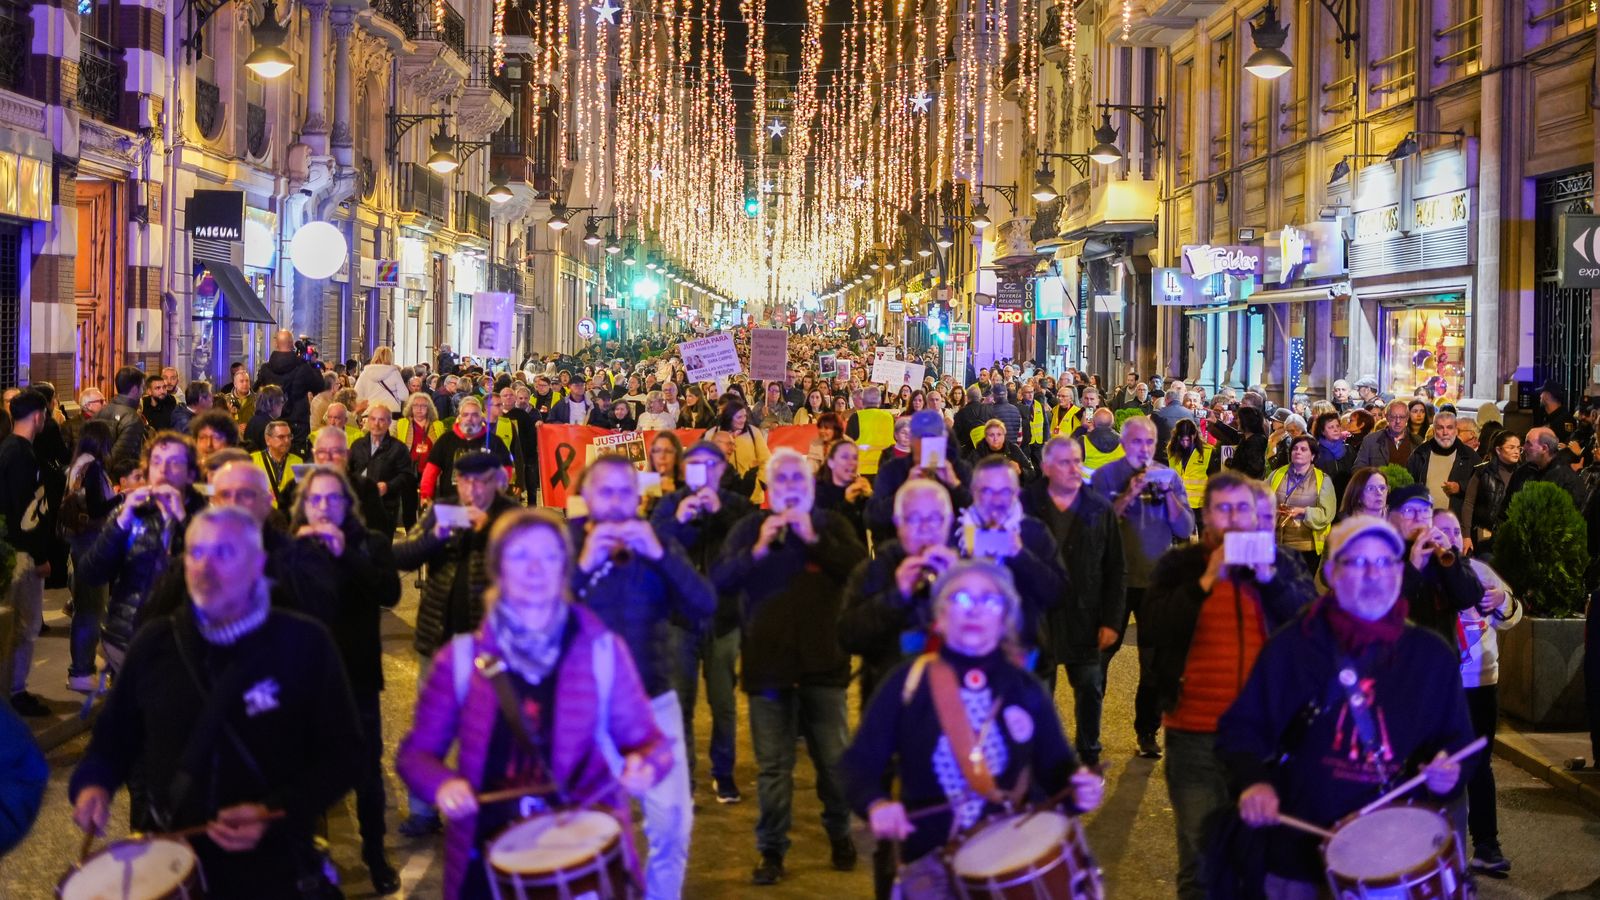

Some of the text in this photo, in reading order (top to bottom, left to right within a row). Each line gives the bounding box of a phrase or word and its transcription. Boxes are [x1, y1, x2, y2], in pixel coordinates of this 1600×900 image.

[195, 226, 239, 238] PASCUAL
[1210, 248, 1258, 270] Folder
[1578, 268, 1600, 278] exp
[1024, 282, 1033, 308] ORO
[710, 335, 728, 344] PARA
[596, 432, 643, 446] JUSTICIA
